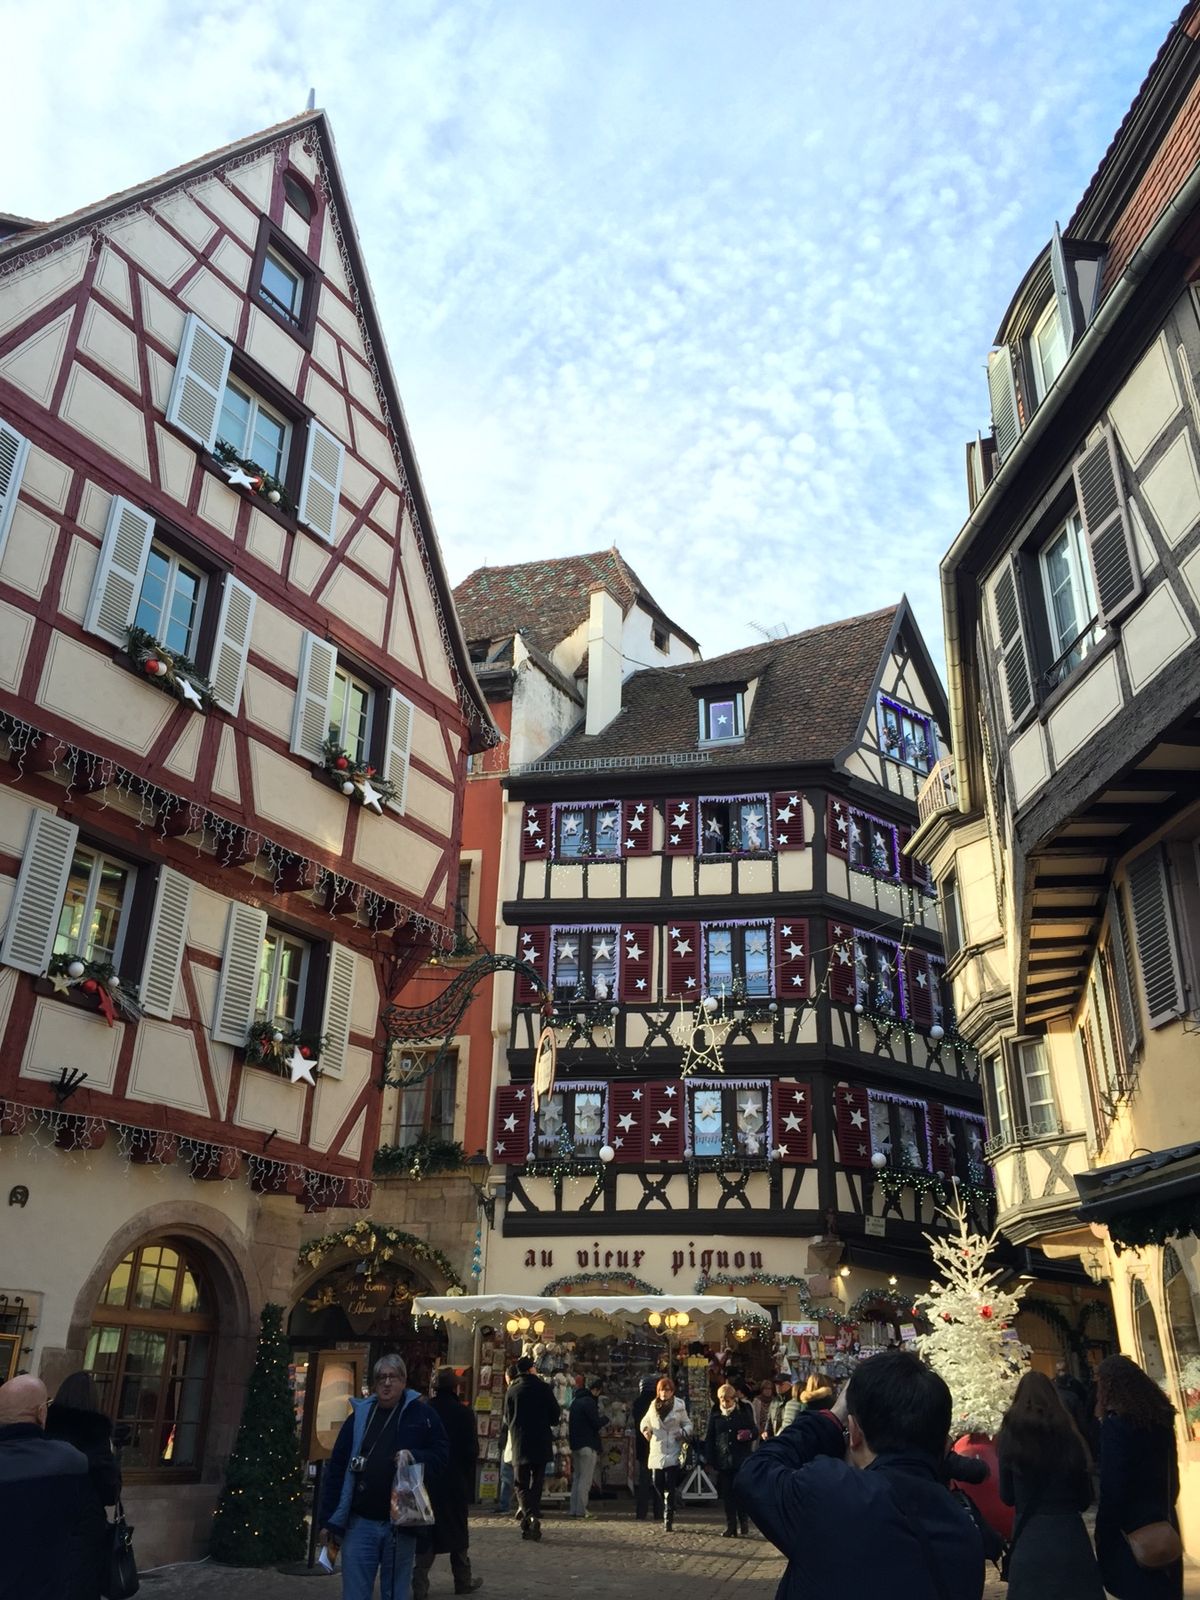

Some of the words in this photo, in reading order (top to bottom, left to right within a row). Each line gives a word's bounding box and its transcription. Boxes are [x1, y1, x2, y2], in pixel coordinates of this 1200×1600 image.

[524, 1248, 554, 1268] au
[576, 1242, 645, 1269] vieux
[672, 1242, 764, 1277] pignon
